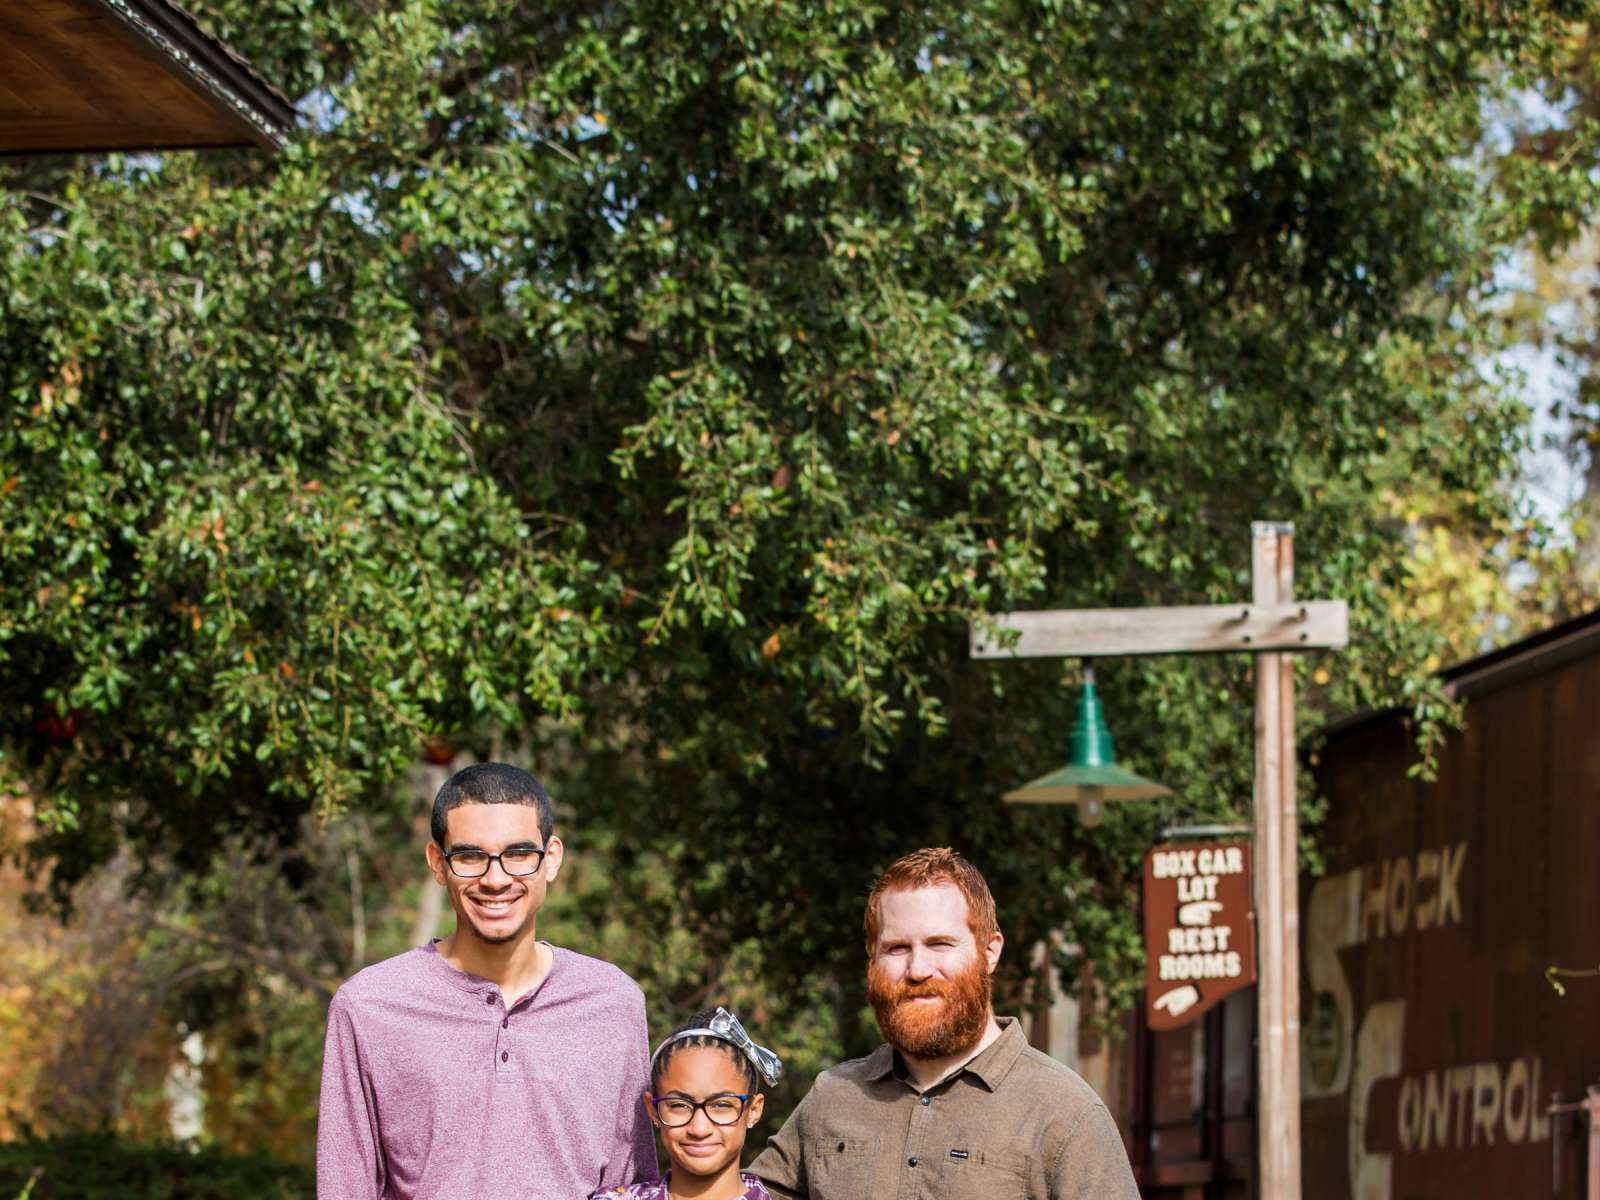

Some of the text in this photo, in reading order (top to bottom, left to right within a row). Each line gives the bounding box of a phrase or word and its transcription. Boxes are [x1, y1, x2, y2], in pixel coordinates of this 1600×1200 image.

[1153, 847, 1243, 878] BOX CAR
[1177, 876, 1219, 901] LOT
[1168, 926, 1231, 953] REST
[1159, 951, 1241, 980] ROOMS
[1300, 842, 1467, 1097] SHOCK
